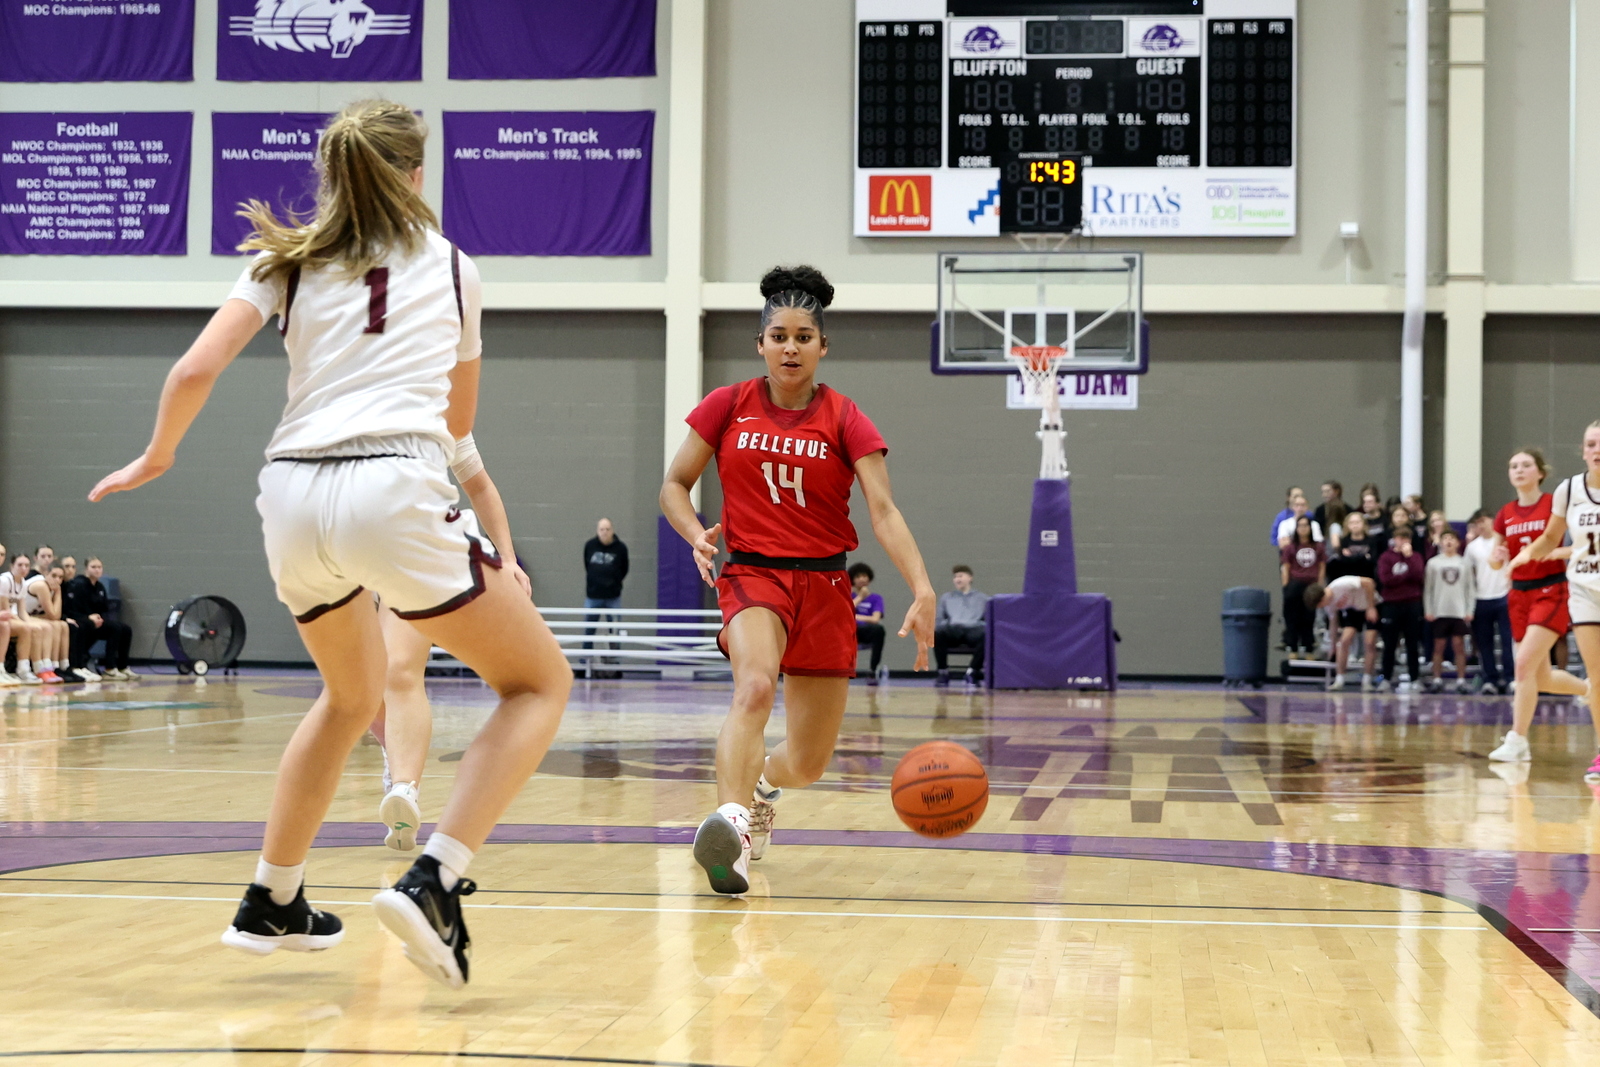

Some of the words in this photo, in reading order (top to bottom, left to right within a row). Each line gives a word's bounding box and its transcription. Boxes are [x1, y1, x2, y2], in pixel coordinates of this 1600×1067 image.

[23, 4, 50, 16] MOC
[52, 4, 117, 17] Champions:
[120, 3, 161, 15] 1965-66
[865, 24, 887, 37] PLYR
[893, 24, 909, 36] FLS
[918, 23, 935, 36] PTS
[1213, 22, 1235, 35] PLYR
[1268, 21, 1285, 34] PTS
[953, 59, 1027, 76] BLUFFTON
[1136, 58, 1186, 75] GUEST
[1055, 67, 1093, 80] PERIOD
[958, 114, 992, 126] FOULS
[1001, 114, 1029, 126] T.O.L.
[1039, 114, 1078, 126] PLAYER
[1082, 114, 1109, 126] FOUL
[1117, 113, 1146, 125] T.O.L.
[1157, 113, 1190, 125] FOULS
[57, 122, 119, 136] Football
[498, 127, 547, 144] Men's
[552, 127, 599, 144] Track
[262, 128, 311, 145] Men's
[12, 140, 45, 151] NWOC
[46, 140, 106, 153] Champions:
[2, 153, 26, 164] MOL
[27, 153, 87, 165] Champions:
[146, 153, 172, 164] 1957,
[222, 148, 250, 160] NAIA
[454, 148, 481, 160] AMC
[483, 148, 550, 162] Champions:
[552, 148, 581, 161] 1992,
[958, 156, 992, 168] SCORE
[1157, 155, 1190, 167] SCORE
[1030, 160, 1075, 184] 1:43
[16, 178, 41, 189] MOC
[43, 178, 102, 191] Champions:
[58, 191, 117, 203] Champions:
[123, 191, 146, 202] 1972
[1091, 184, 1182, 214] RITA'S
[1, 204, 26, 214] NAIA
[28, 203, 69, 214] National
[70, 203, 114, 216] Playoffs:
[30, 216, 54, 227] AMC
[55, 216, 115, 229] Champions:
[870, 214, 897, 226] Lewis
[898, 214, 930, 227] Family
[1100, 217, 1181, 229] PARTNERS
[25, 229, 55, 240] HCAC
[57, 229, 116, 241] Champions:
[362, 266, 389, 334] 1
[1075, 374, 1127, 395] DAM
[737, 432, 828, 460] BELLEVUE
[761, 461, 806, 508] 14
[1505, 519, 1546, 537] BELLEVUE
